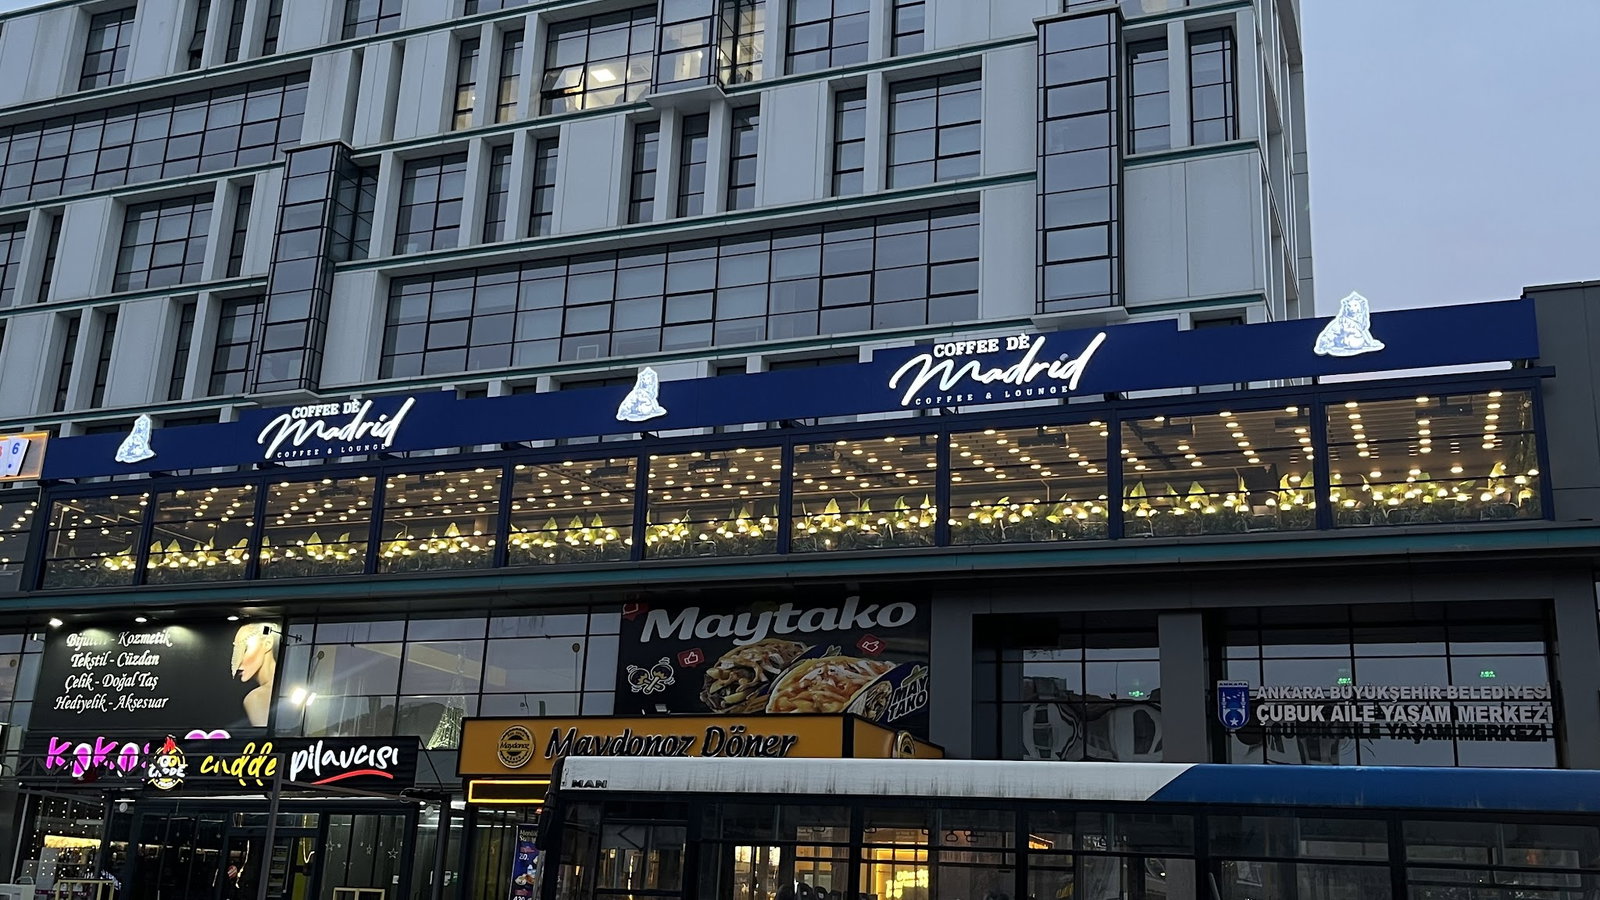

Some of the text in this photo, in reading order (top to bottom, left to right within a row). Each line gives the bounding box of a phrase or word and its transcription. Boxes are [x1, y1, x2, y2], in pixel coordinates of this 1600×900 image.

[933, 336, 1000, 358] COFFEE
[888, 331, 1107, 406] Madrid
[914, 385, 1069, 406] COFFEE & LOUNGE
[291, 402, 340, 419] COFFEE
[257, 396, 417, 460] Madrid
[276, 448, 320, 459] COFFEE
[340, 443, 386, 454] LOUNGE
[639, 595, 917, 647] Maytako
[117, 628, 174, 648] Kozmetik
[70, 650, 112, 670] Tekstil
[116, 649, 160, 668] Cüzdan
[64, 672, 95, 694] Çelik
[101, 671, 140, 692] Doğal
[138, 671, 160, 691] Taş
[1255, 682, 1552, 703] ANKARA BÜYÜKŞEHİR BELEDİYESİ
[53, 693, 108, 714] Hediyelik
[112, 692, 170, 712] Aksesuar
[887, 689, 929, 723] TAKO
[1255, 704, 1325, 726] ÇUBUK
[1330, 700, 1376, 722] AİLE
[1380, 704, 1451, 726] YAŞAM
[544, 725, 799, 758] Maydonoz Döner
[289, 740, 399, 782] pilavcısı
[571, 779, 608, 789] MAN
